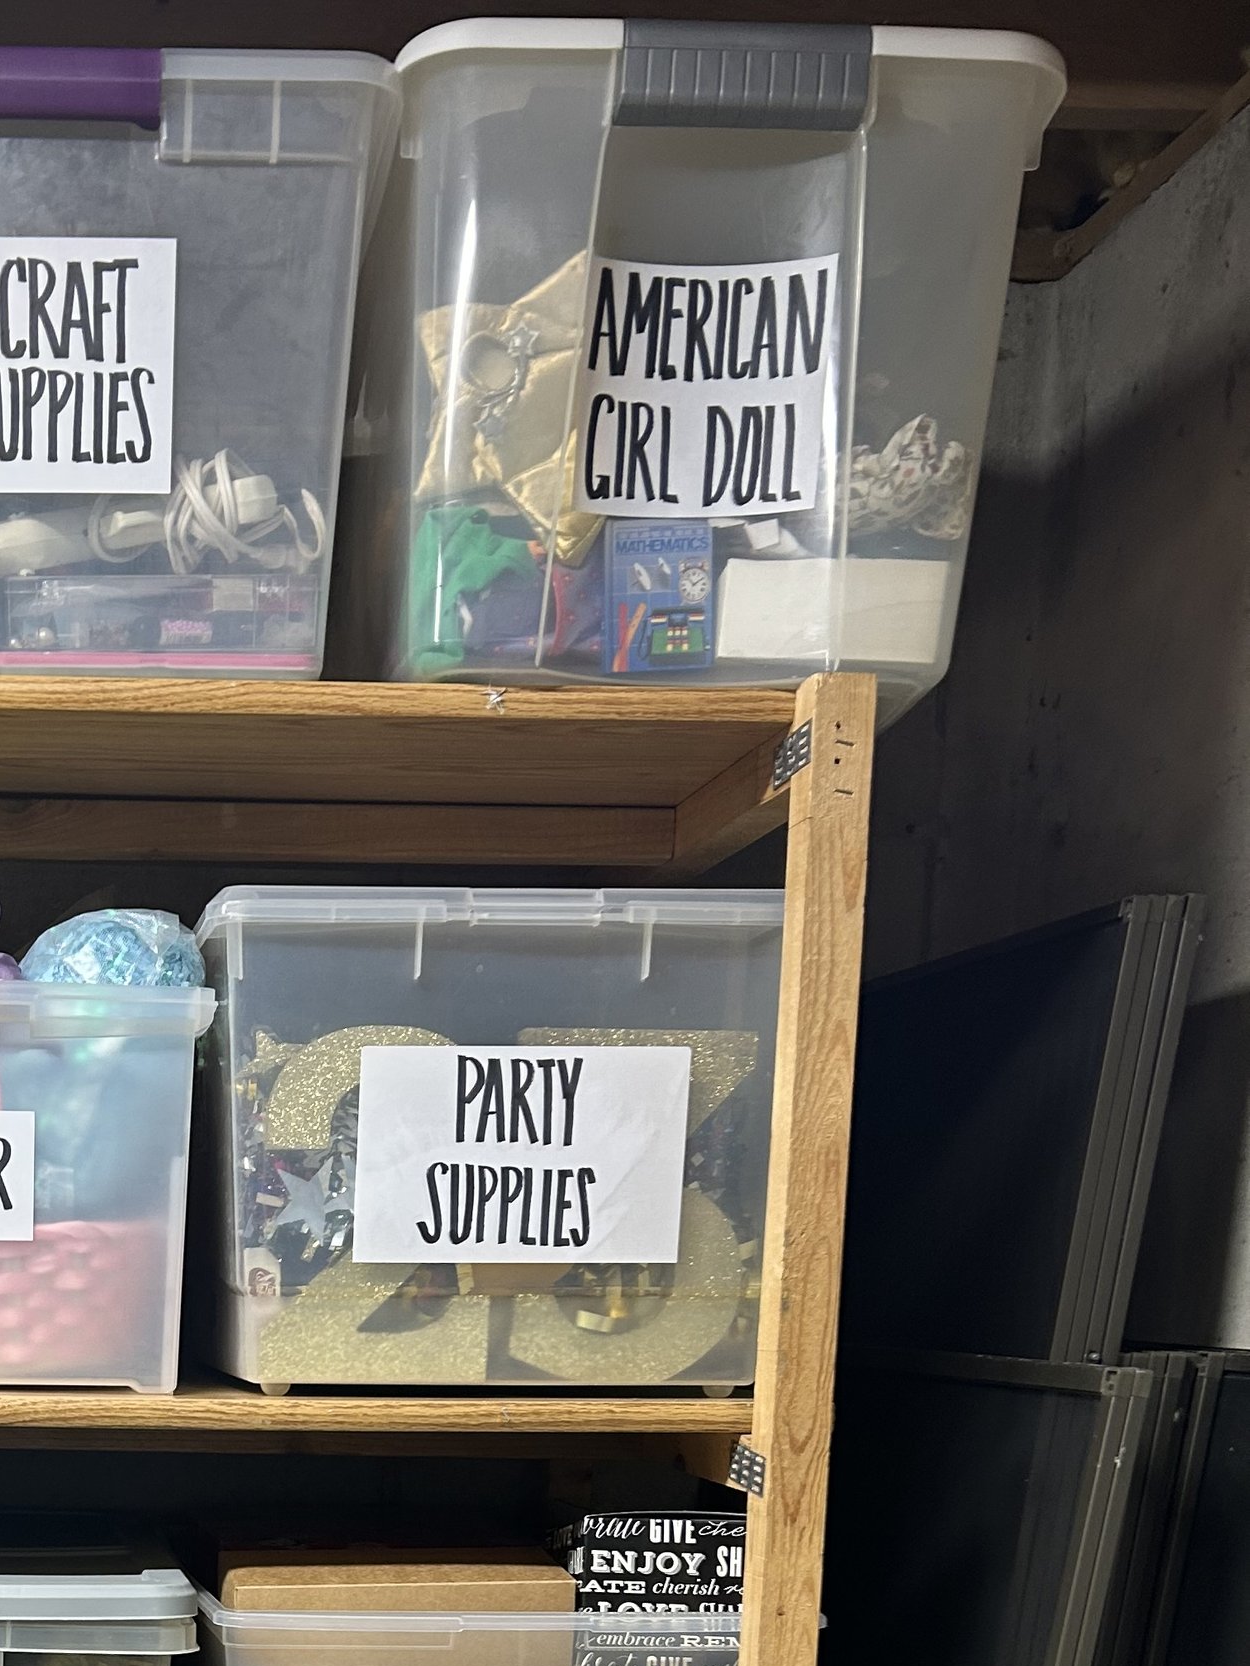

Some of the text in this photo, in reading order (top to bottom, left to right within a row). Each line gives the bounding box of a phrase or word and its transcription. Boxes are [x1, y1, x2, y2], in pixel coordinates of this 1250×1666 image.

[0, 258, 138, 363] CRAFT
[588, 267, 827, 382] AMERICAN
[585, 394, 800, 507] GIRL DOLL
[615, 536, 709, 554] MATHEMATICS
[456, 1055, 583, 1146] PARTY
[416, 1162, 595, 1247] SUPPLIES
[650, 1518, 697, 1544] GIVE
[590, 1549, 706, 1576] ENJOY
[716, 1545, 743, 1578] SH
[652, 1577, 719, 1596] cherish
[596, 1631, 675, 1647] embrace
